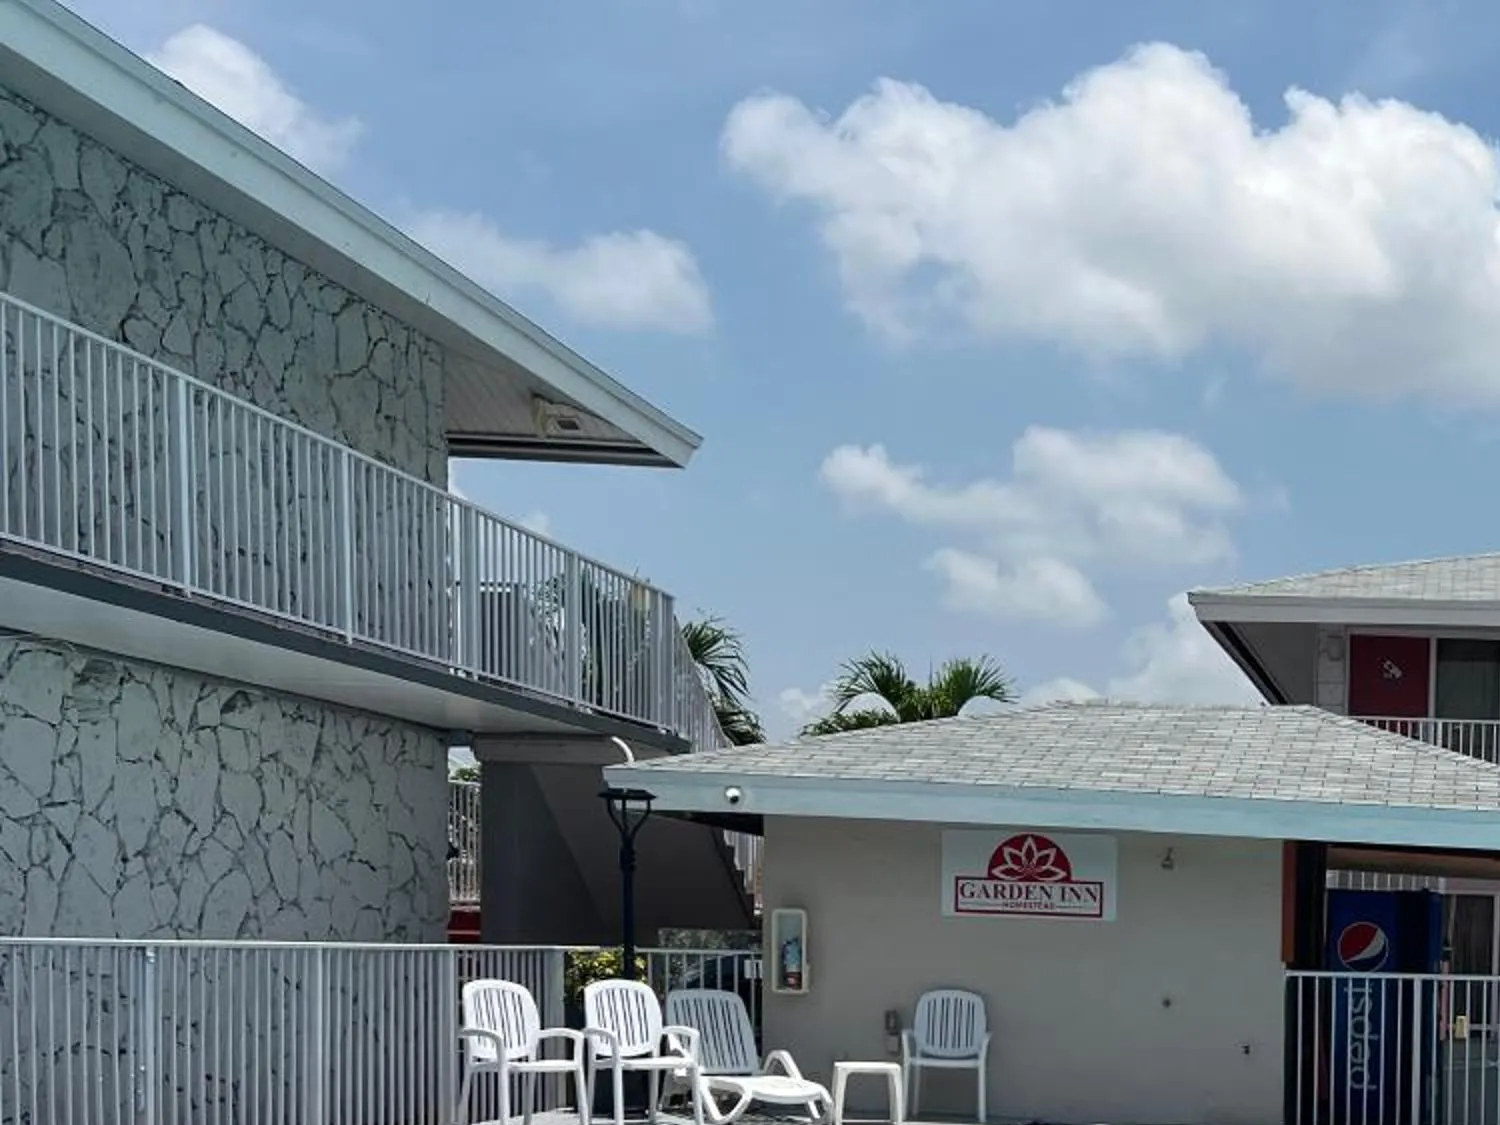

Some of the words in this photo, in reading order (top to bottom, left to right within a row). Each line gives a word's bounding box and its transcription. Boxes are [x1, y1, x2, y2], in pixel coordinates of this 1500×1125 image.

[959, 881, 1054, 901] GARDEN
[1060, 885, 1098, 905] INN
[1344, 985, 1379, 1089] pepsi
